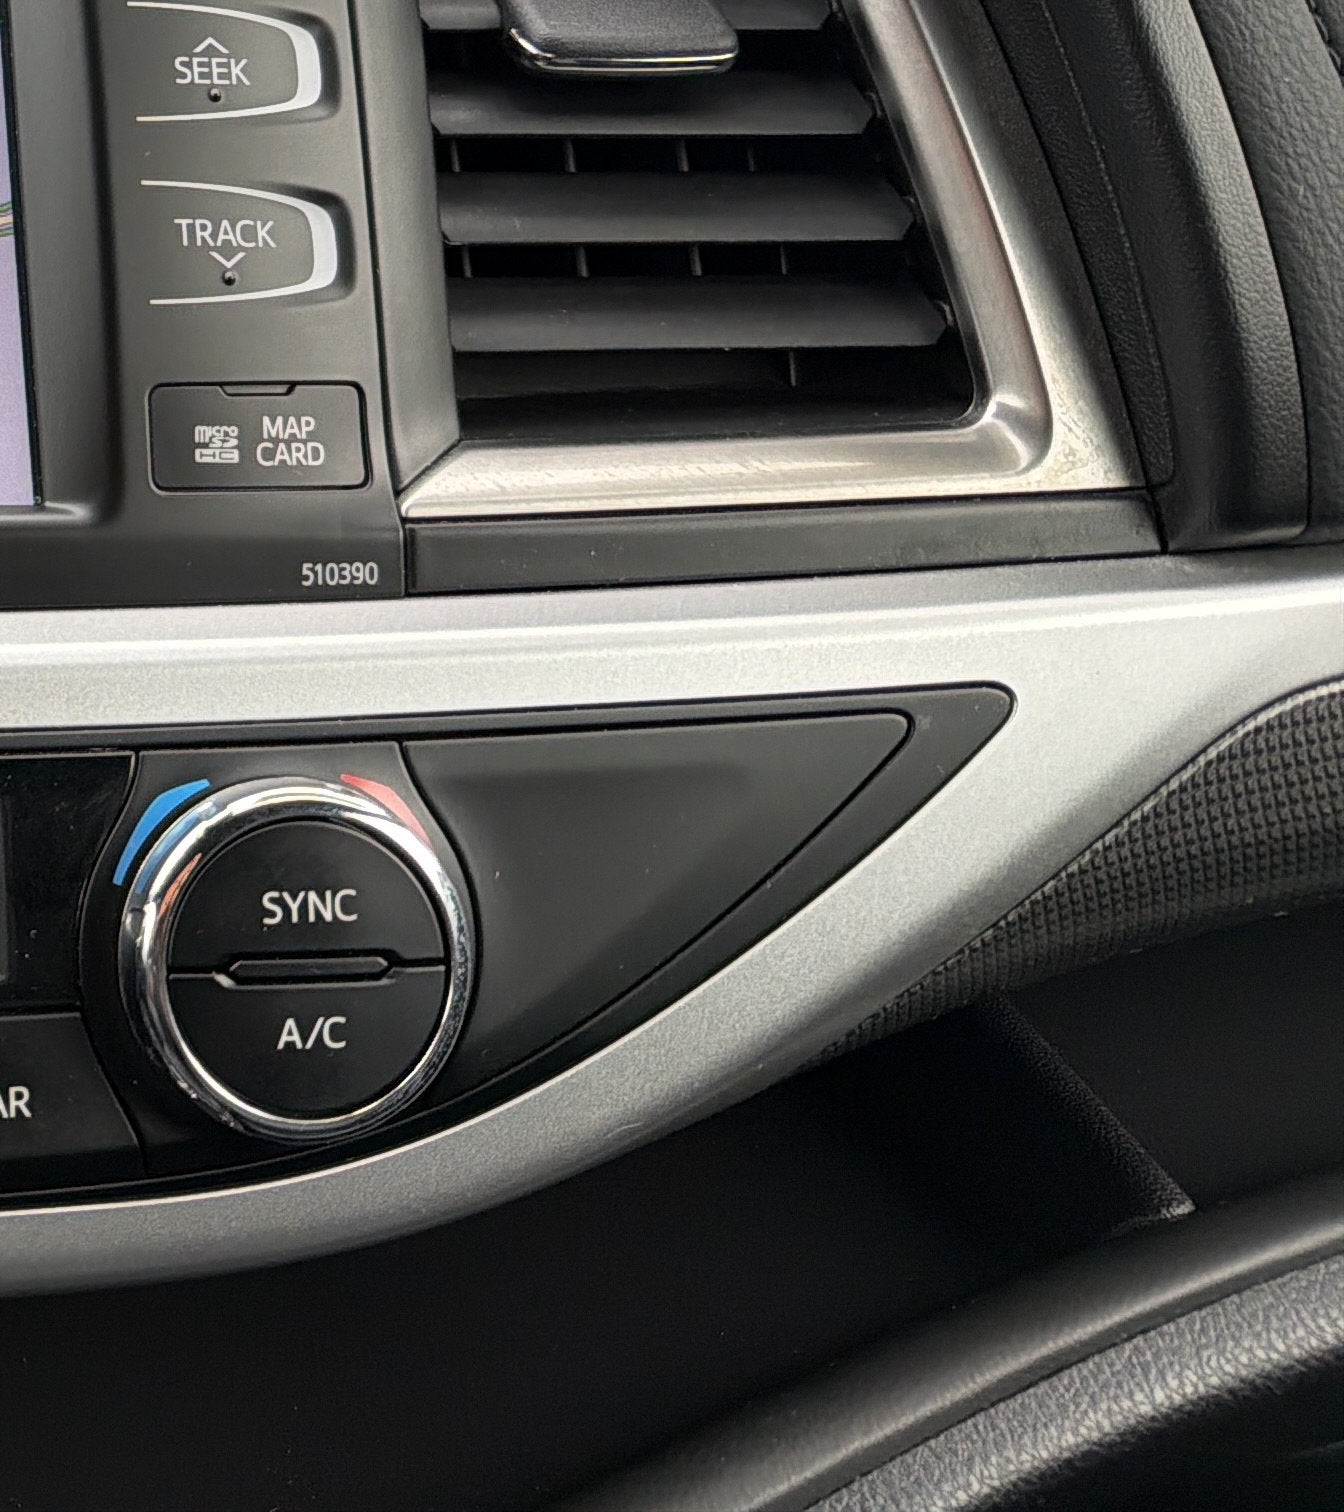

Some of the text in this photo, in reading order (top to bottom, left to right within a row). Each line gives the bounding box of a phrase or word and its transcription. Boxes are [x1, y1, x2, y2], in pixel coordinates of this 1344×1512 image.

[174, 56, 251, 86] SEEK
[173, 218, 277, 249] TRACK
[262, 415, 316, 440] MAP
[256, 441, 325, 467] CARD
[301, 561, 379, 587] 510390
[262, 888, 358, 925] SYNC
[277, 1016, 347, 1050] A/C
